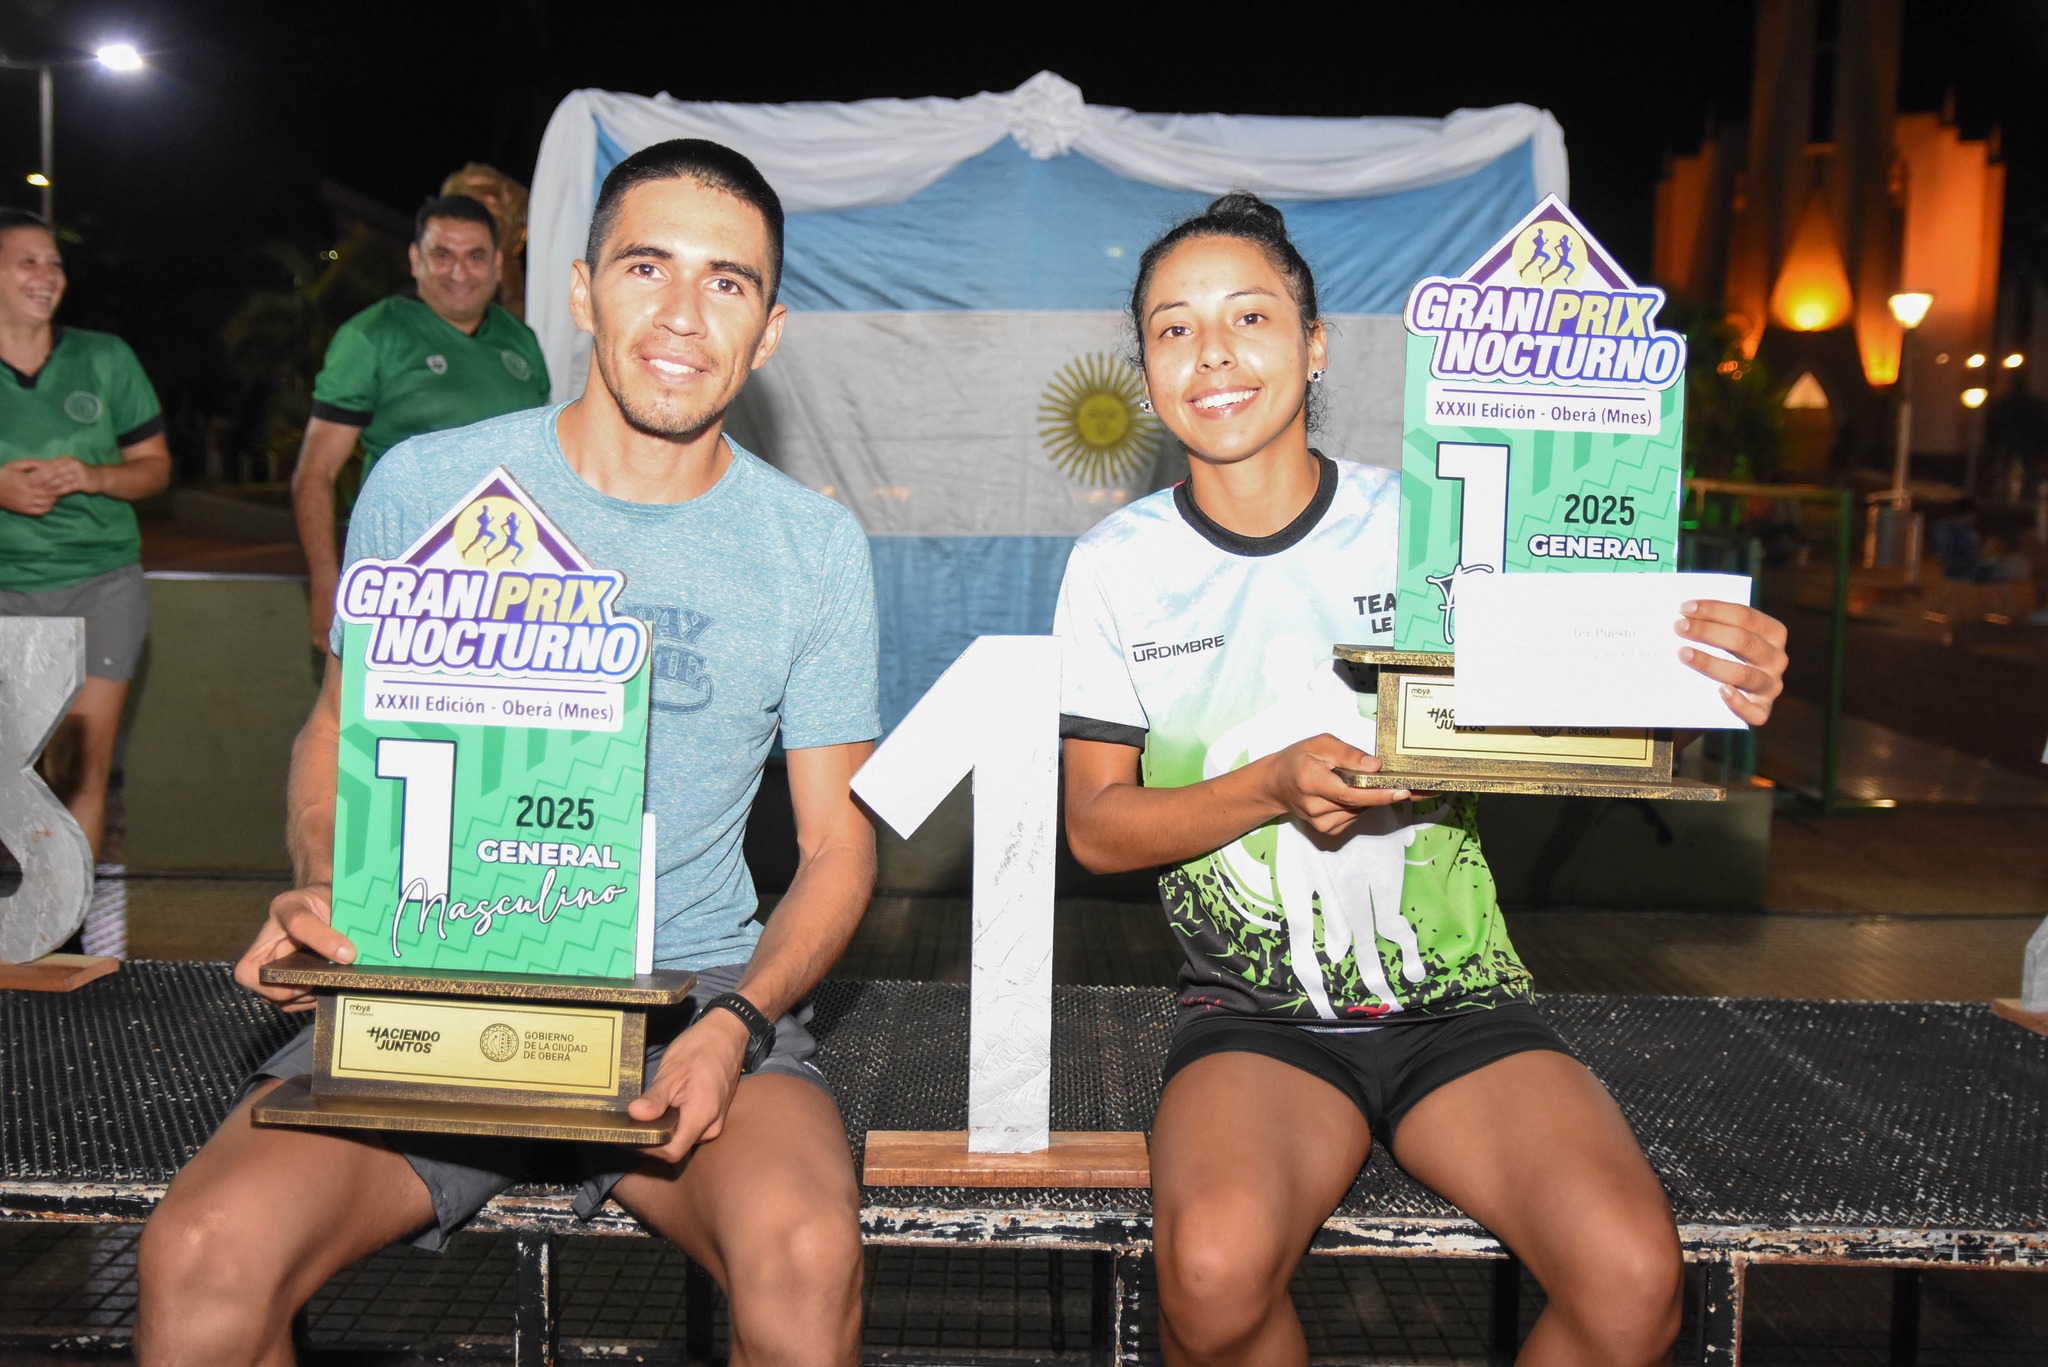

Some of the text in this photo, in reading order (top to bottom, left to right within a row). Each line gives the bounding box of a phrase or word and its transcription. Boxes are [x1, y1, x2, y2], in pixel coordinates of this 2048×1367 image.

[1416, 286, 1656, 337] GRAN PRIX
[1442, 332, 1676, 383] NOCTURNO
[1435, 401, 1476, 416] XXXII
[1481, 403, 1536, 419] Edición
[1551, 406, 1597, 422] Oberá
[1601, 408, 1653, 427] (Mnes)
[1436, 441, 1511, 573] 1
[1564, 494, 1635, 526] 2025
[1527, 534, 1659, 562] GENERAL
[348, 570, 614, 625] GRAN PRIX
[1353, 592, 1396, 615] TEA
[1371, 617, 1395, 634] LE
[1596, 628, 1636, 638] Puesto
[376, 618, 635, 675] NOCTURNO
[1132, 634, 1226, 662] URDIMBRE
[375, 693, 420, 710] XXXII
[425, 696, 485, 713] Edición
[502, 699, 552, 718] Oberá
[558, 701, 614, 723] (Mnes)
[1427, 708, 1455, 723] HAC
[376, 737, 457, 902] 1
[516, 795, 595, 831] 2025
[477, 839, 620, 869] GENERAL
[850, 635, 1062, 1153] 1
[391, 868, 626, 958] Masculino
[366, 1026, 441, 1043] HACIENDO
[377, 1040, 432, 1054] JUNTOS
[524, 1031, 575, 1042] GOBIERNO
[524, 1041, 588, 1053] DE LA CIUDAD
[523, 1051, 571, 1061] DE OBERÁ
